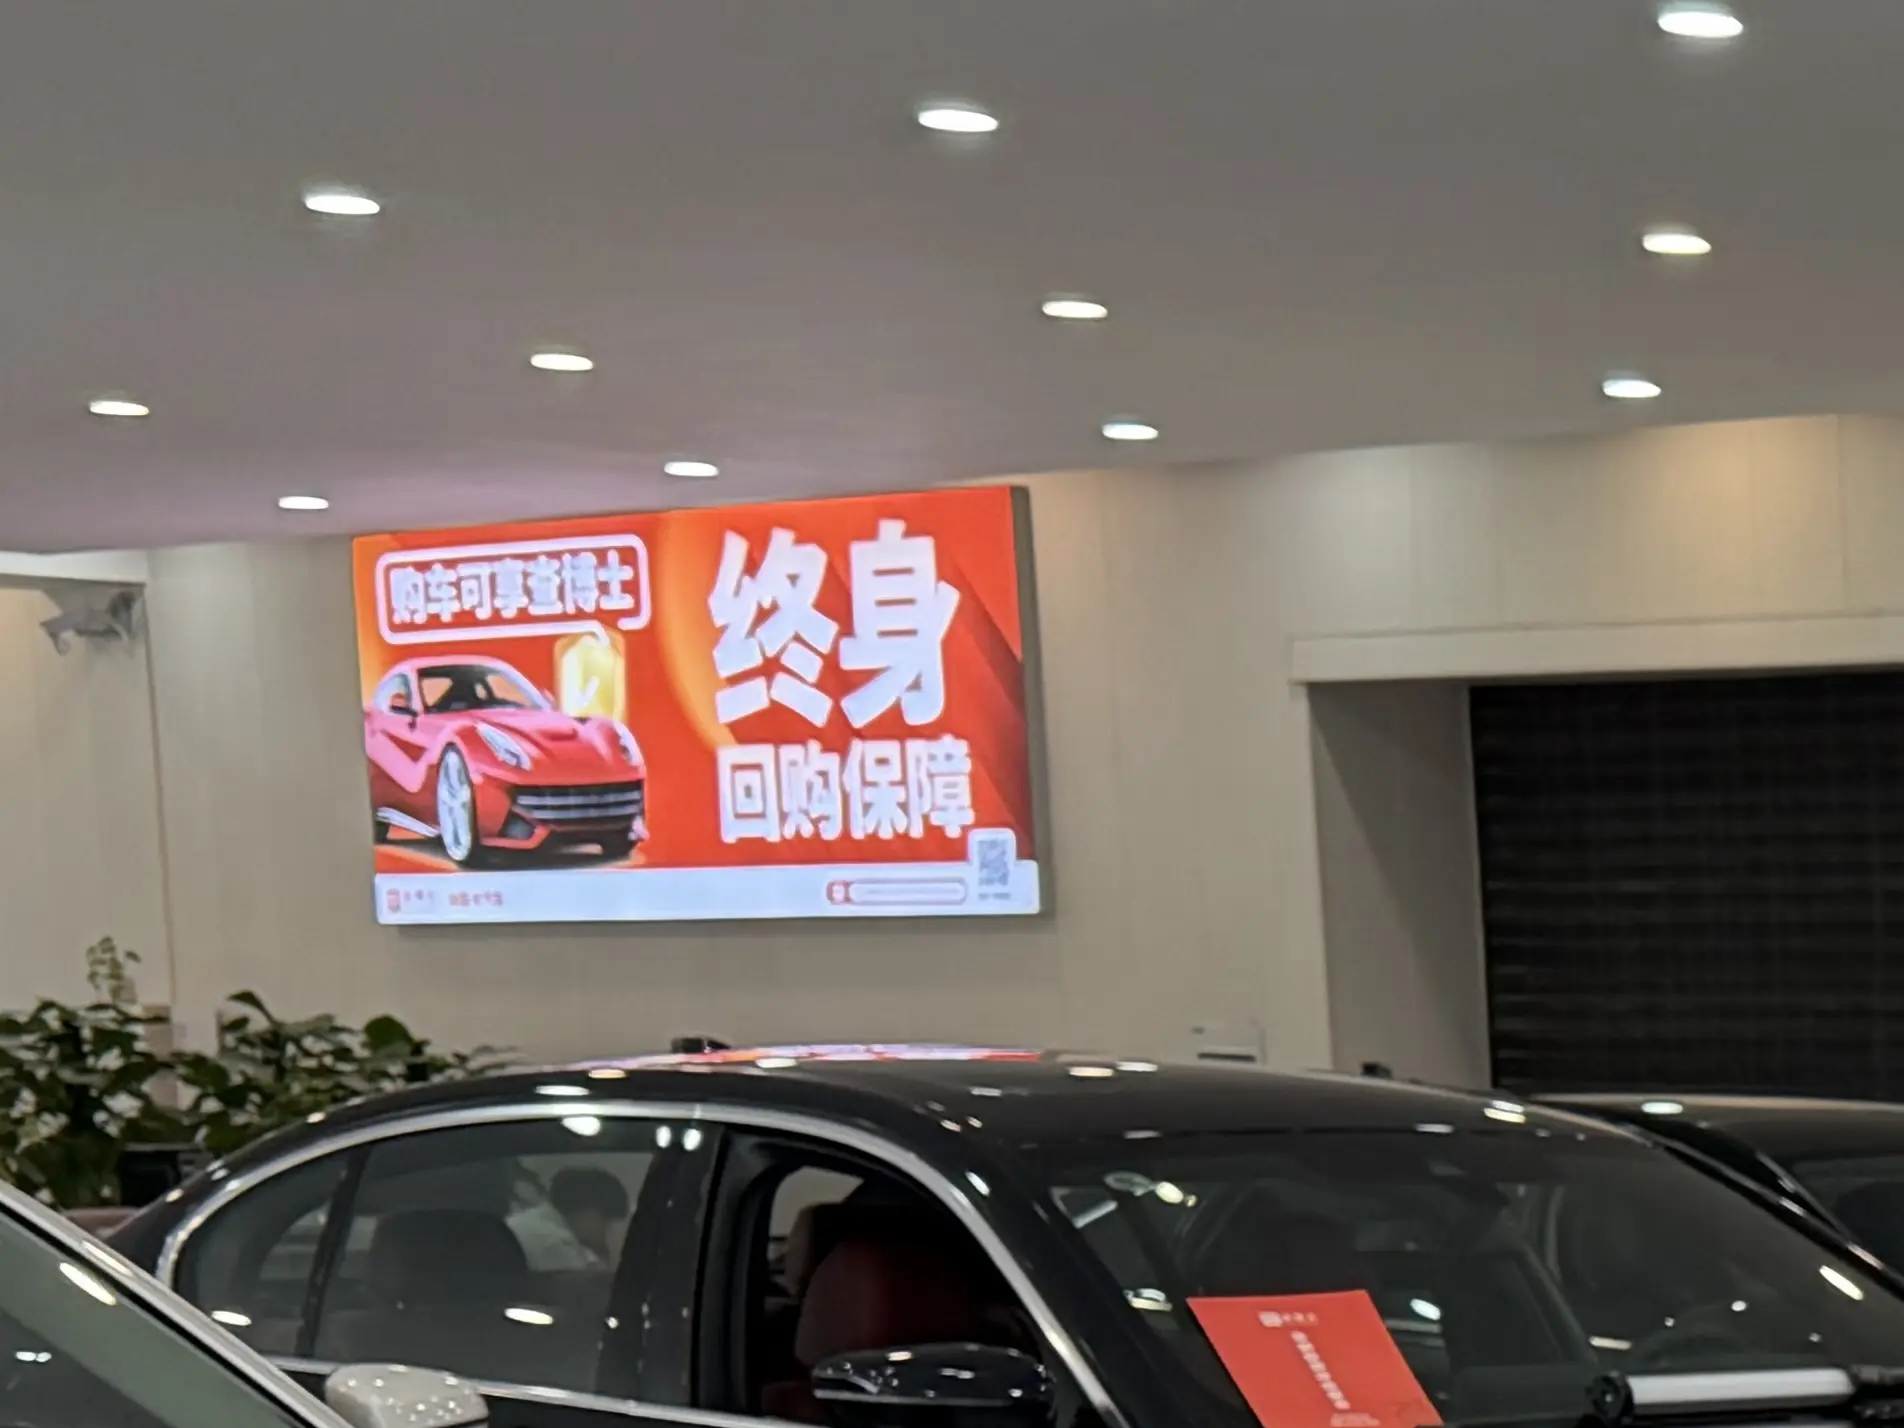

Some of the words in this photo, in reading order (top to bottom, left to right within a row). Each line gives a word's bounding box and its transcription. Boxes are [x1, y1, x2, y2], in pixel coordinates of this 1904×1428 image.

[389, 549, 635, 625] 购车可享查博士
[707, 519, 960, 730] 终身
[717, 735, 976, 845] 回购保障
